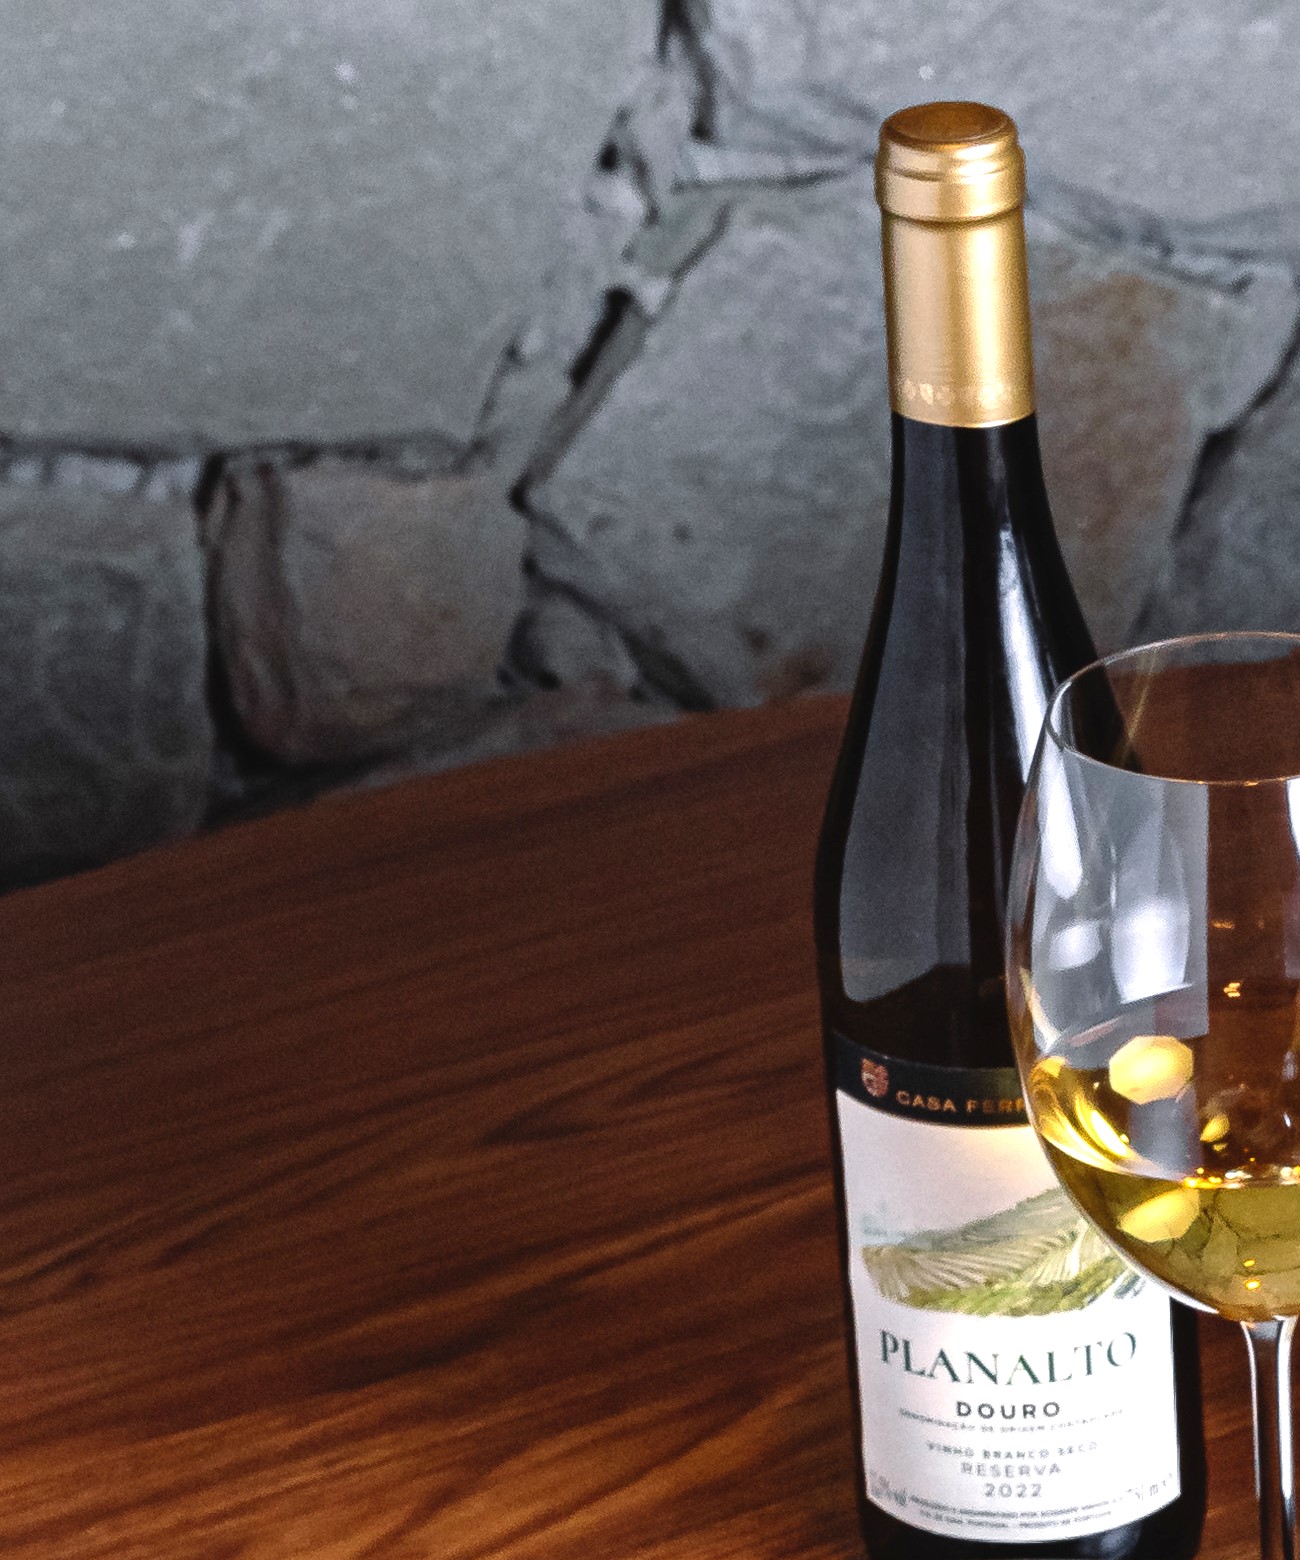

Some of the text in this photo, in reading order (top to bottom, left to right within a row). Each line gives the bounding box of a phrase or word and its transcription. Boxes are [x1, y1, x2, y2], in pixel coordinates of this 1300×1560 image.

[896, 1090, 957, 1113] CASA
[881, 1329, 1138, 1386] PLANALTO
[957, 1401, 1060, 1419] DOURO
[982, 1449, 1050, 1460] BRANCO
[960, 1462, 1061, 1478] RESERVA
[984, 1483, 1042, 1498] 2022
